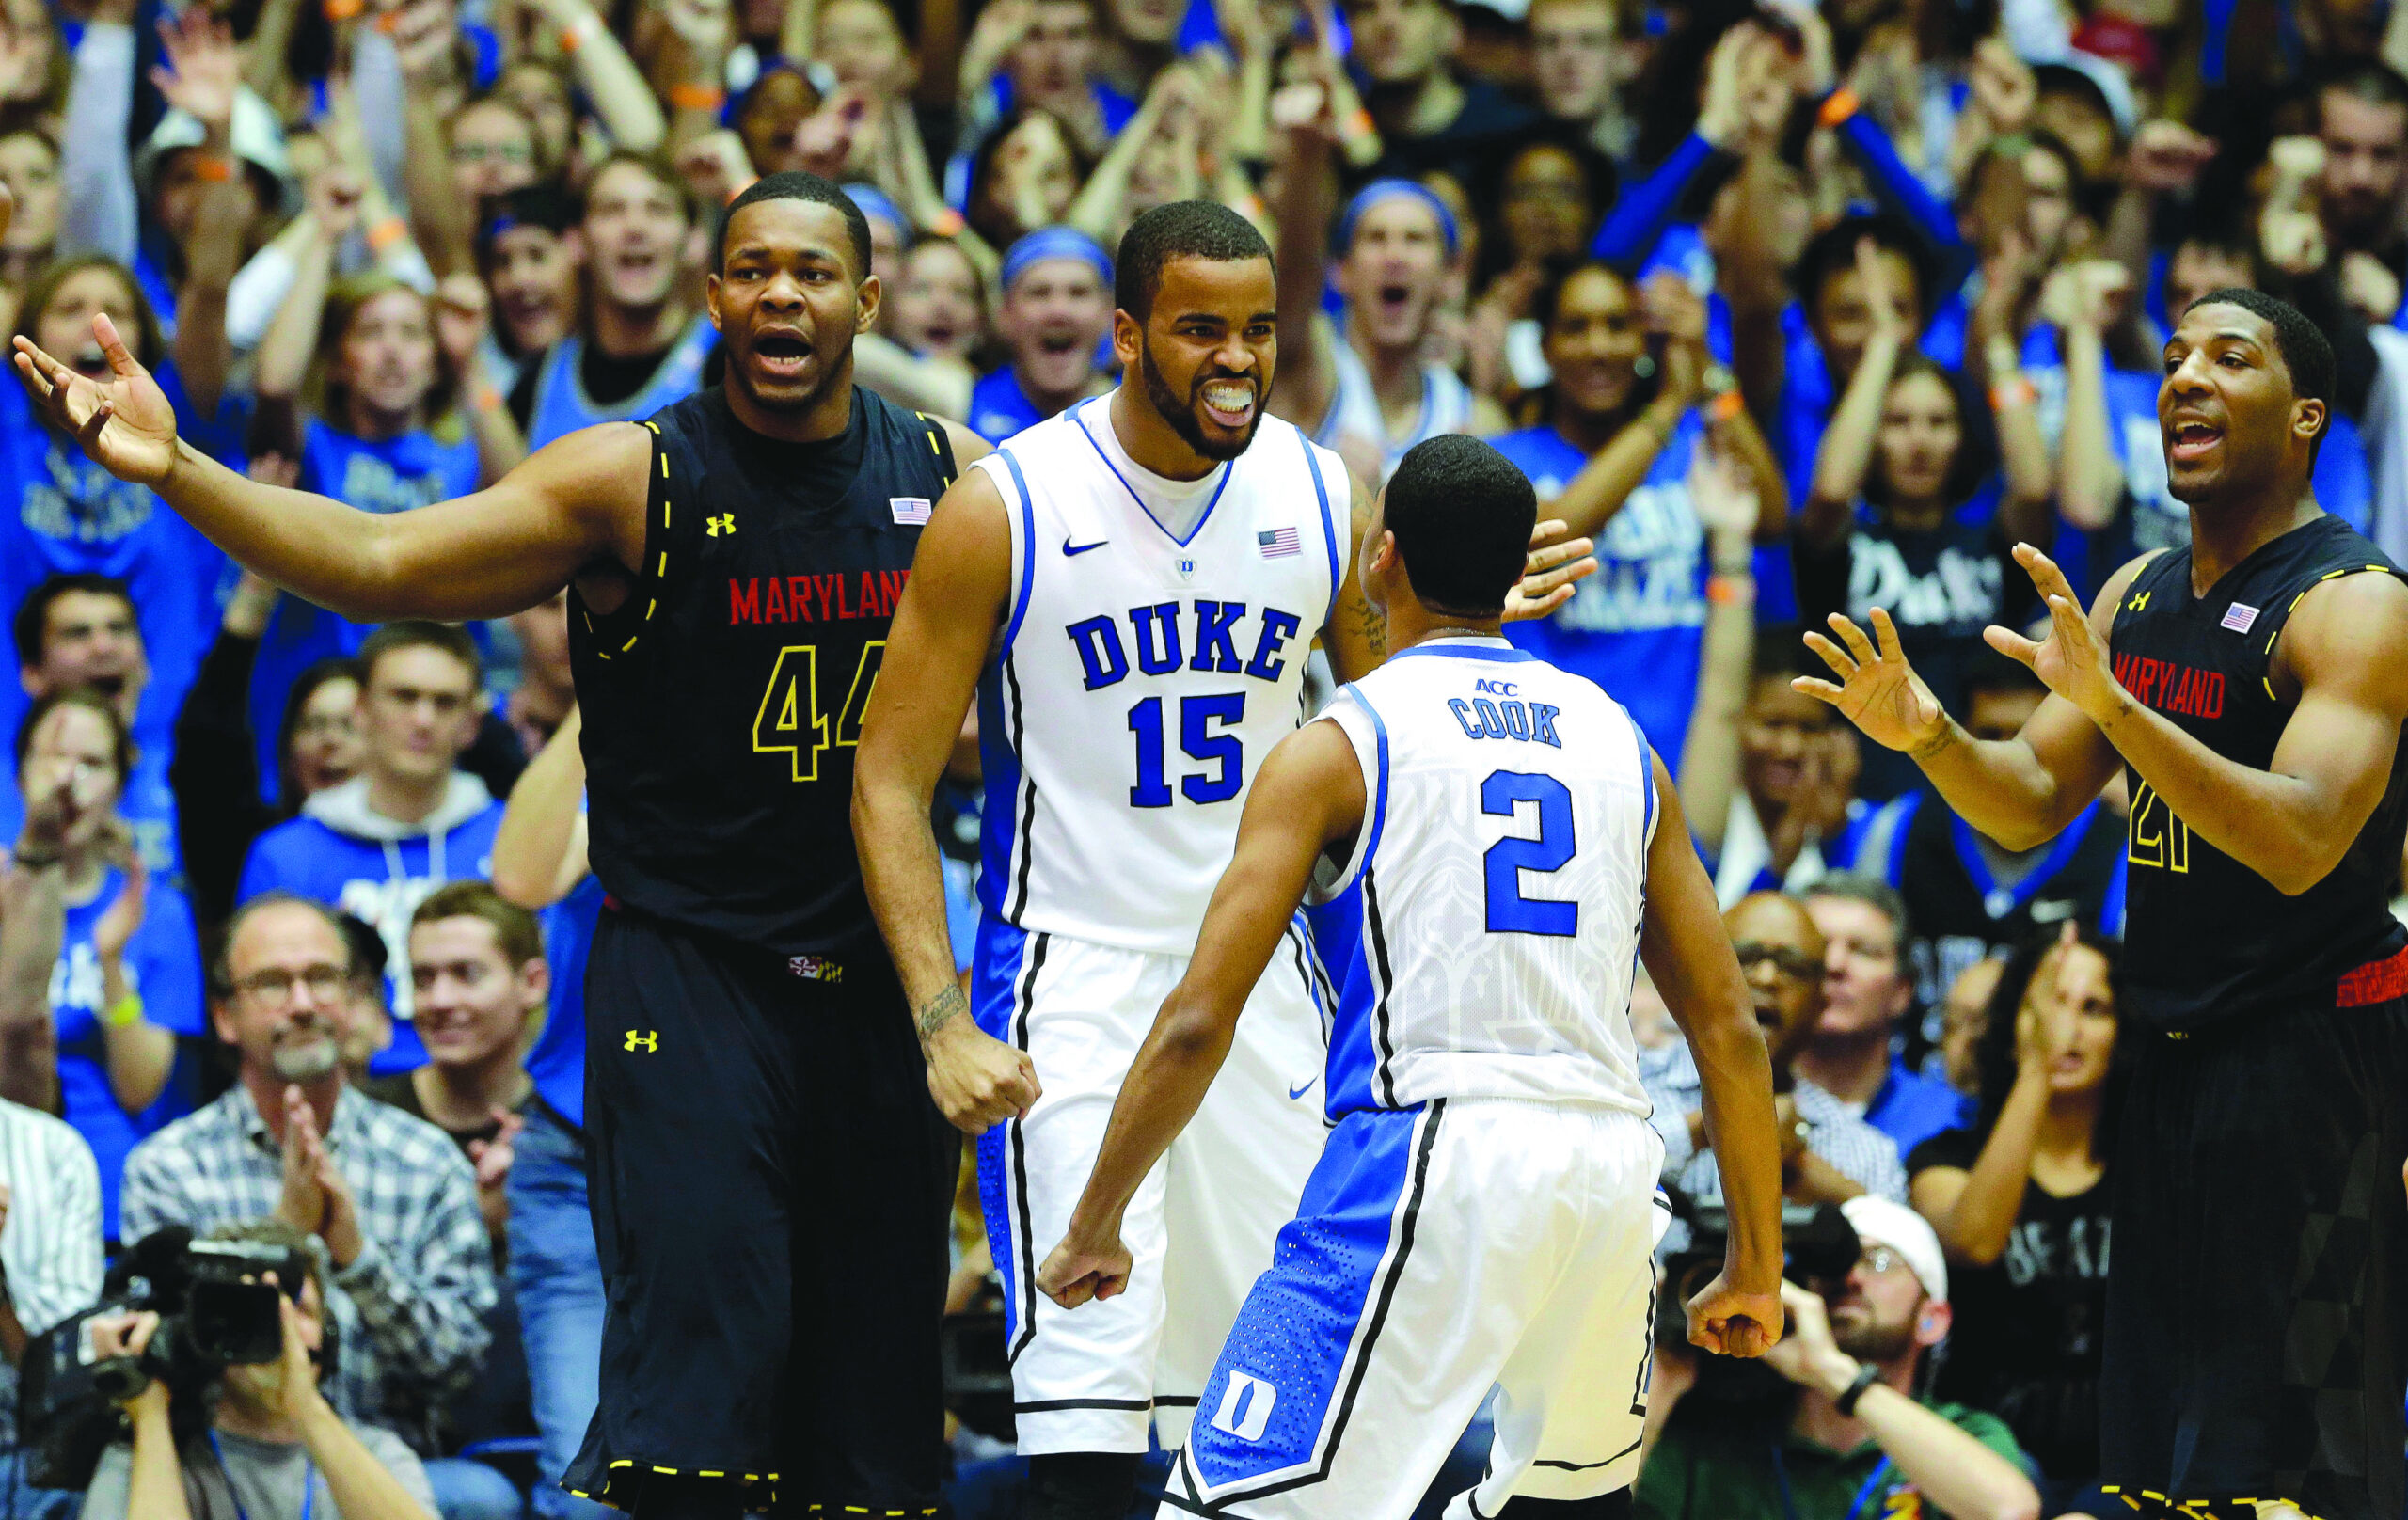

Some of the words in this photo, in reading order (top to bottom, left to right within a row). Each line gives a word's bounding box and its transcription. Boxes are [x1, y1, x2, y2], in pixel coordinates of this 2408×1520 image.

[728, 569, 911, 625] MARYLAN
[1065, 599, 1302, 691] DUKE
[1474, 678, 1519, 697] ACC
[2115, 651, 2226, 720] MARYLAND
[1127, 691, 1246, 808] 15
[1447, 698, 1562, 750] COOK
[1480, 769, 1579, 938] 2
[1209, 1369, 1278, 1443] D
